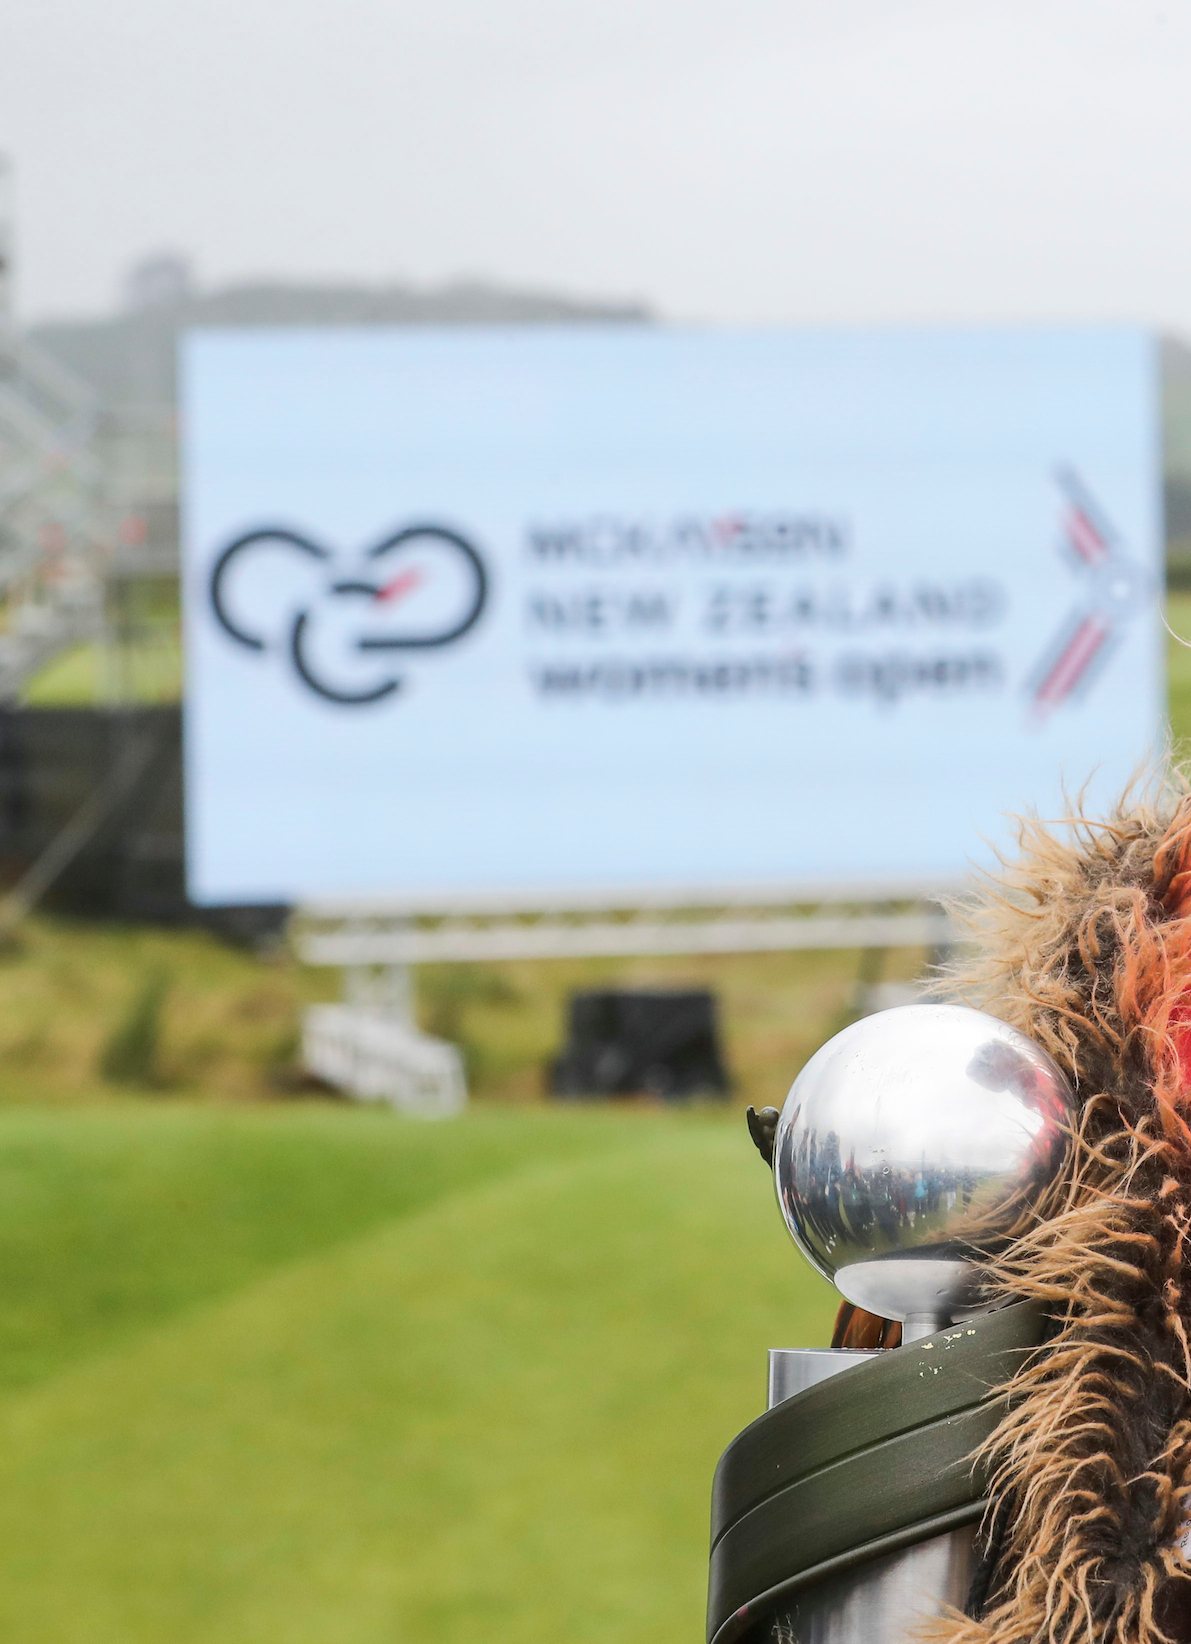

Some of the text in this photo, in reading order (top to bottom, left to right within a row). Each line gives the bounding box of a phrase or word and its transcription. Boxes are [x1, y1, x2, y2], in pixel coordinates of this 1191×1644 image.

[527, 582, 1006, 635] NEW ZEALAND
[835, 652, 1003, 709] open
